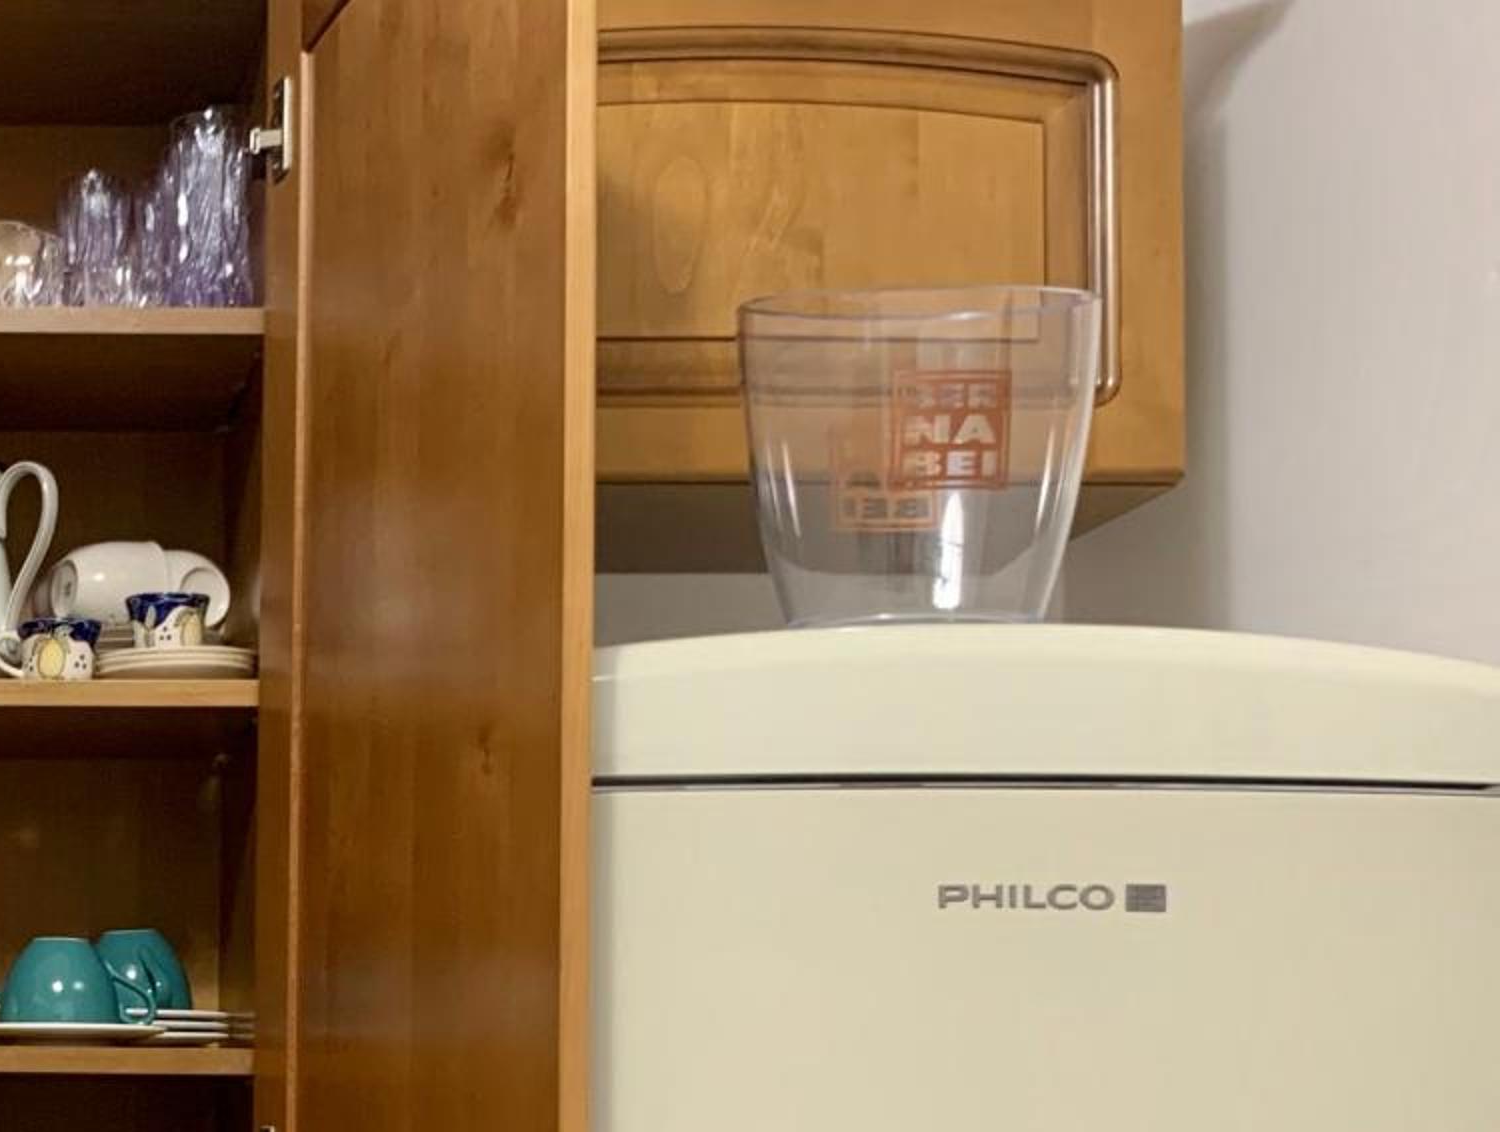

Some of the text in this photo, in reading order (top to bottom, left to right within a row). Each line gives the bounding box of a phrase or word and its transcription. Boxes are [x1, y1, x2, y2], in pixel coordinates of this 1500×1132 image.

[903, 413, 997, 445] NA
[902, 450, 997, 476] BEI
[937, 883, 1116, 911] PHILCO
